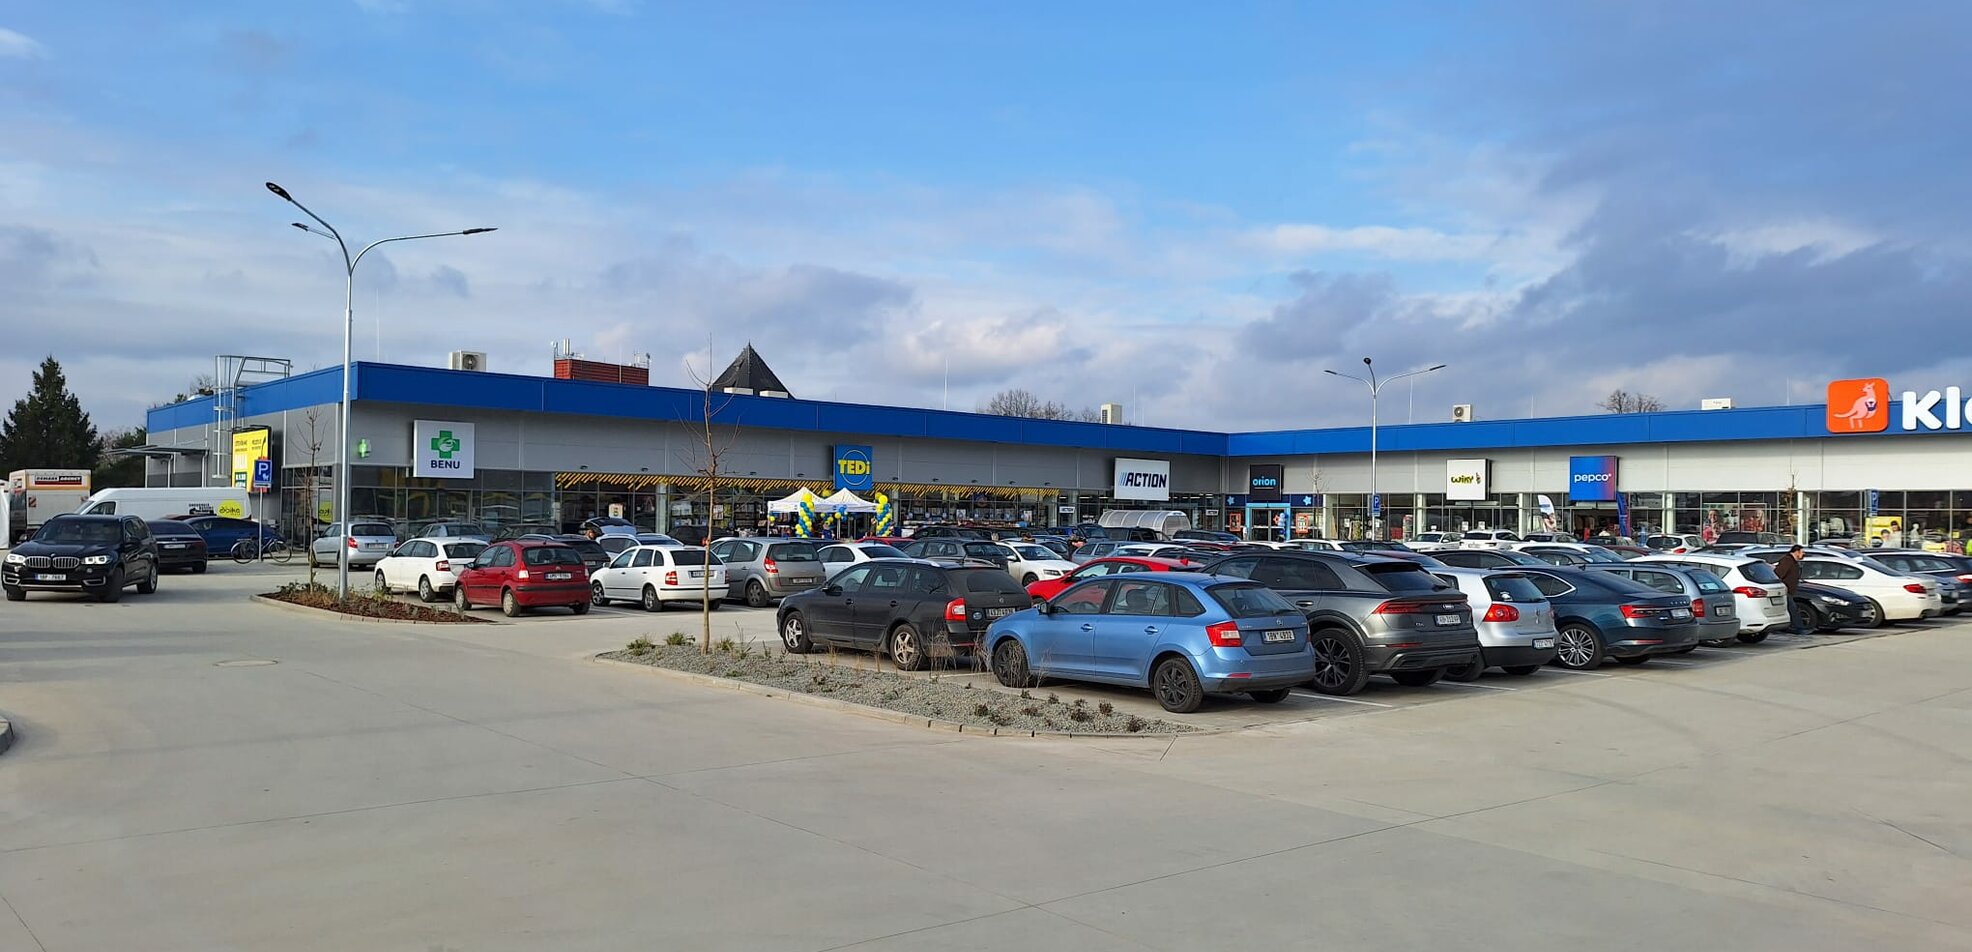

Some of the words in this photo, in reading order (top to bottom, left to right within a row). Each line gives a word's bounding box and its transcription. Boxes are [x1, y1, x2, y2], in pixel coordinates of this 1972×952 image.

[258, 462, 269, 476] P
[431, 459, 460, 469] BENU
[838, 459, 870, 475] TEDi
[1125, 472, 1167, 488] ACTION
[1252, 476, 1276, 486] orion
[1574, 474, 1609, 483] pepco
[1374, 496, 1380, 507] P
